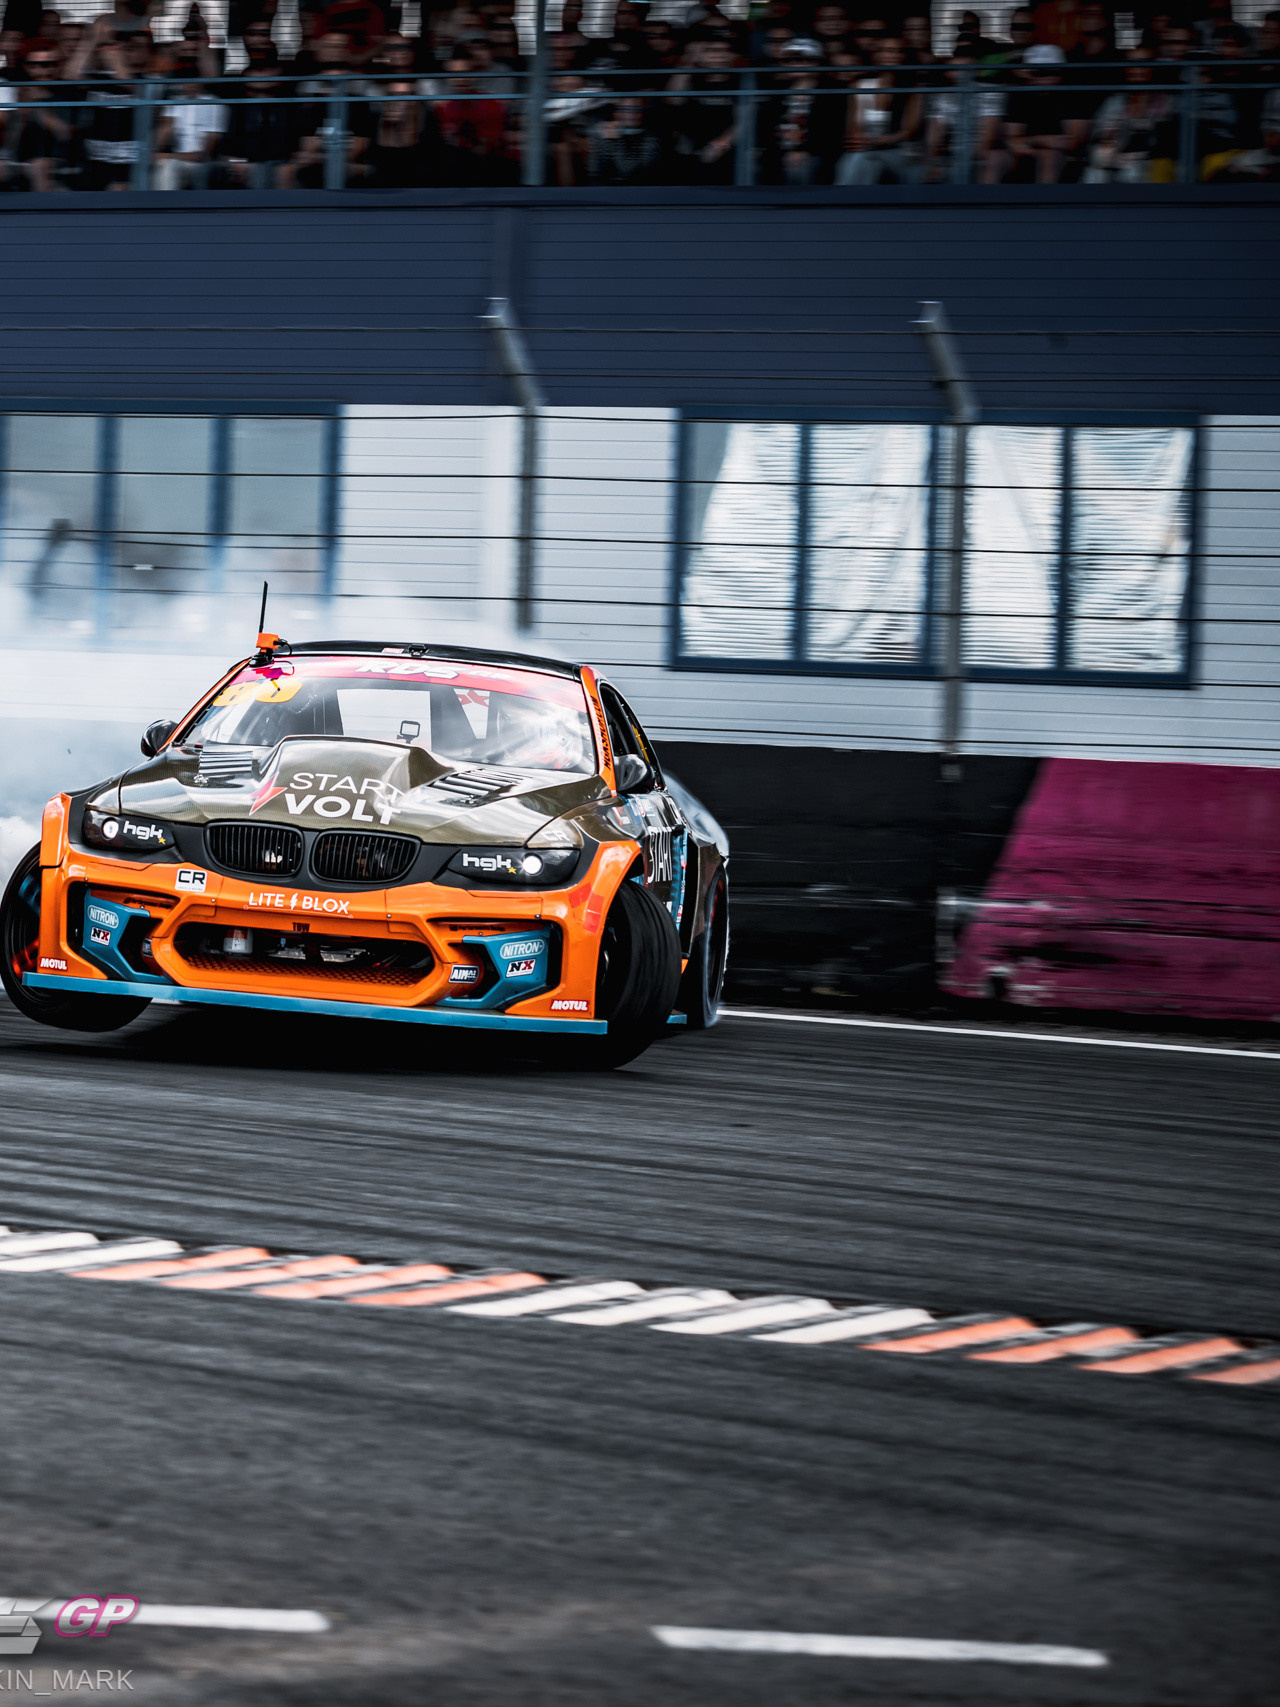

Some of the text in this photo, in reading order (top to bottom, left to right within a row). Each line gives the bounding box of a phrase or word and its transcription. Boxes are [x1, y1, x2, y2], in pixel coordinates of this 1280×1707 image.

[355, 660, 467, 679] RDS
[289, 772, 406, 803] START
[284, 793, 402, 825] VOLT
[123, 821, 163, 840] hgk
[463, 853, 512, 871] hgk
[178, 870, 206, 885] CR
[248, 892, 350, 914] LITE BLOX
[89, 908, 115, 925] NITRON
[91, 928, 110, 942] NX
[504, 940, 540, 955] NITRON
[40, 958, 67, 970] MOTUL
[509, 959, 535, 972] NX
[550, 1000, 588, 1011] MOTUL
